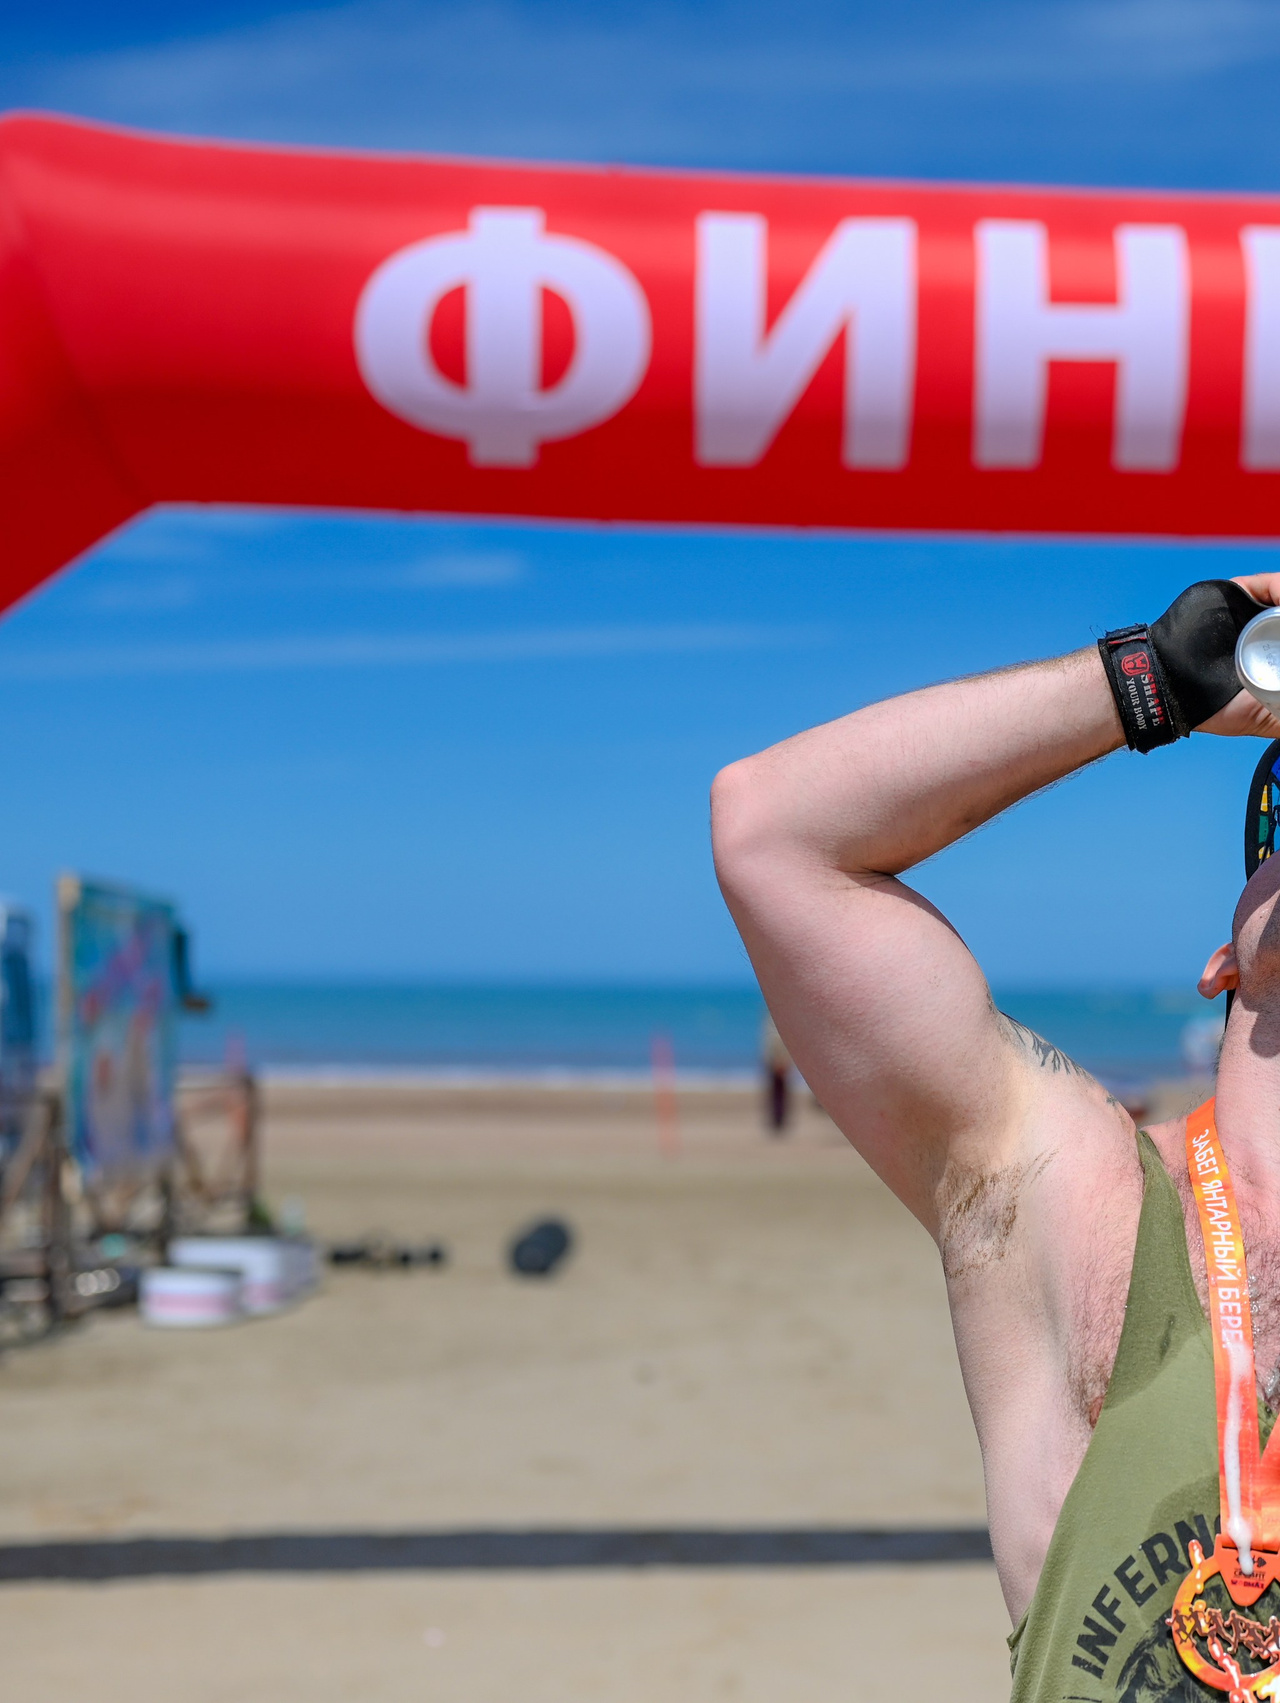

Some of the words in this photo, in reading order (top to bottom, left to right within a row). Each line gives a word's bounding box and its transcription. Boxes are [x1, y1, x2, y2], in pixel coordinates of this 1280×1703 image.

[1126, 677, 1140, 706] YOUR
[1133, 706, 1147, 730] BODY
[1141, 673, 1165, 726] SHAPE
[1192, 1129, 1219, 1175] ЗАБЕГ
[1201, 1179, 1242, 1281] ЯНТАРНЫЙ
[1217, 1286, 1244, 1349] БЕРЕ
[1071, 1513, 1221, 1680] INFERN
